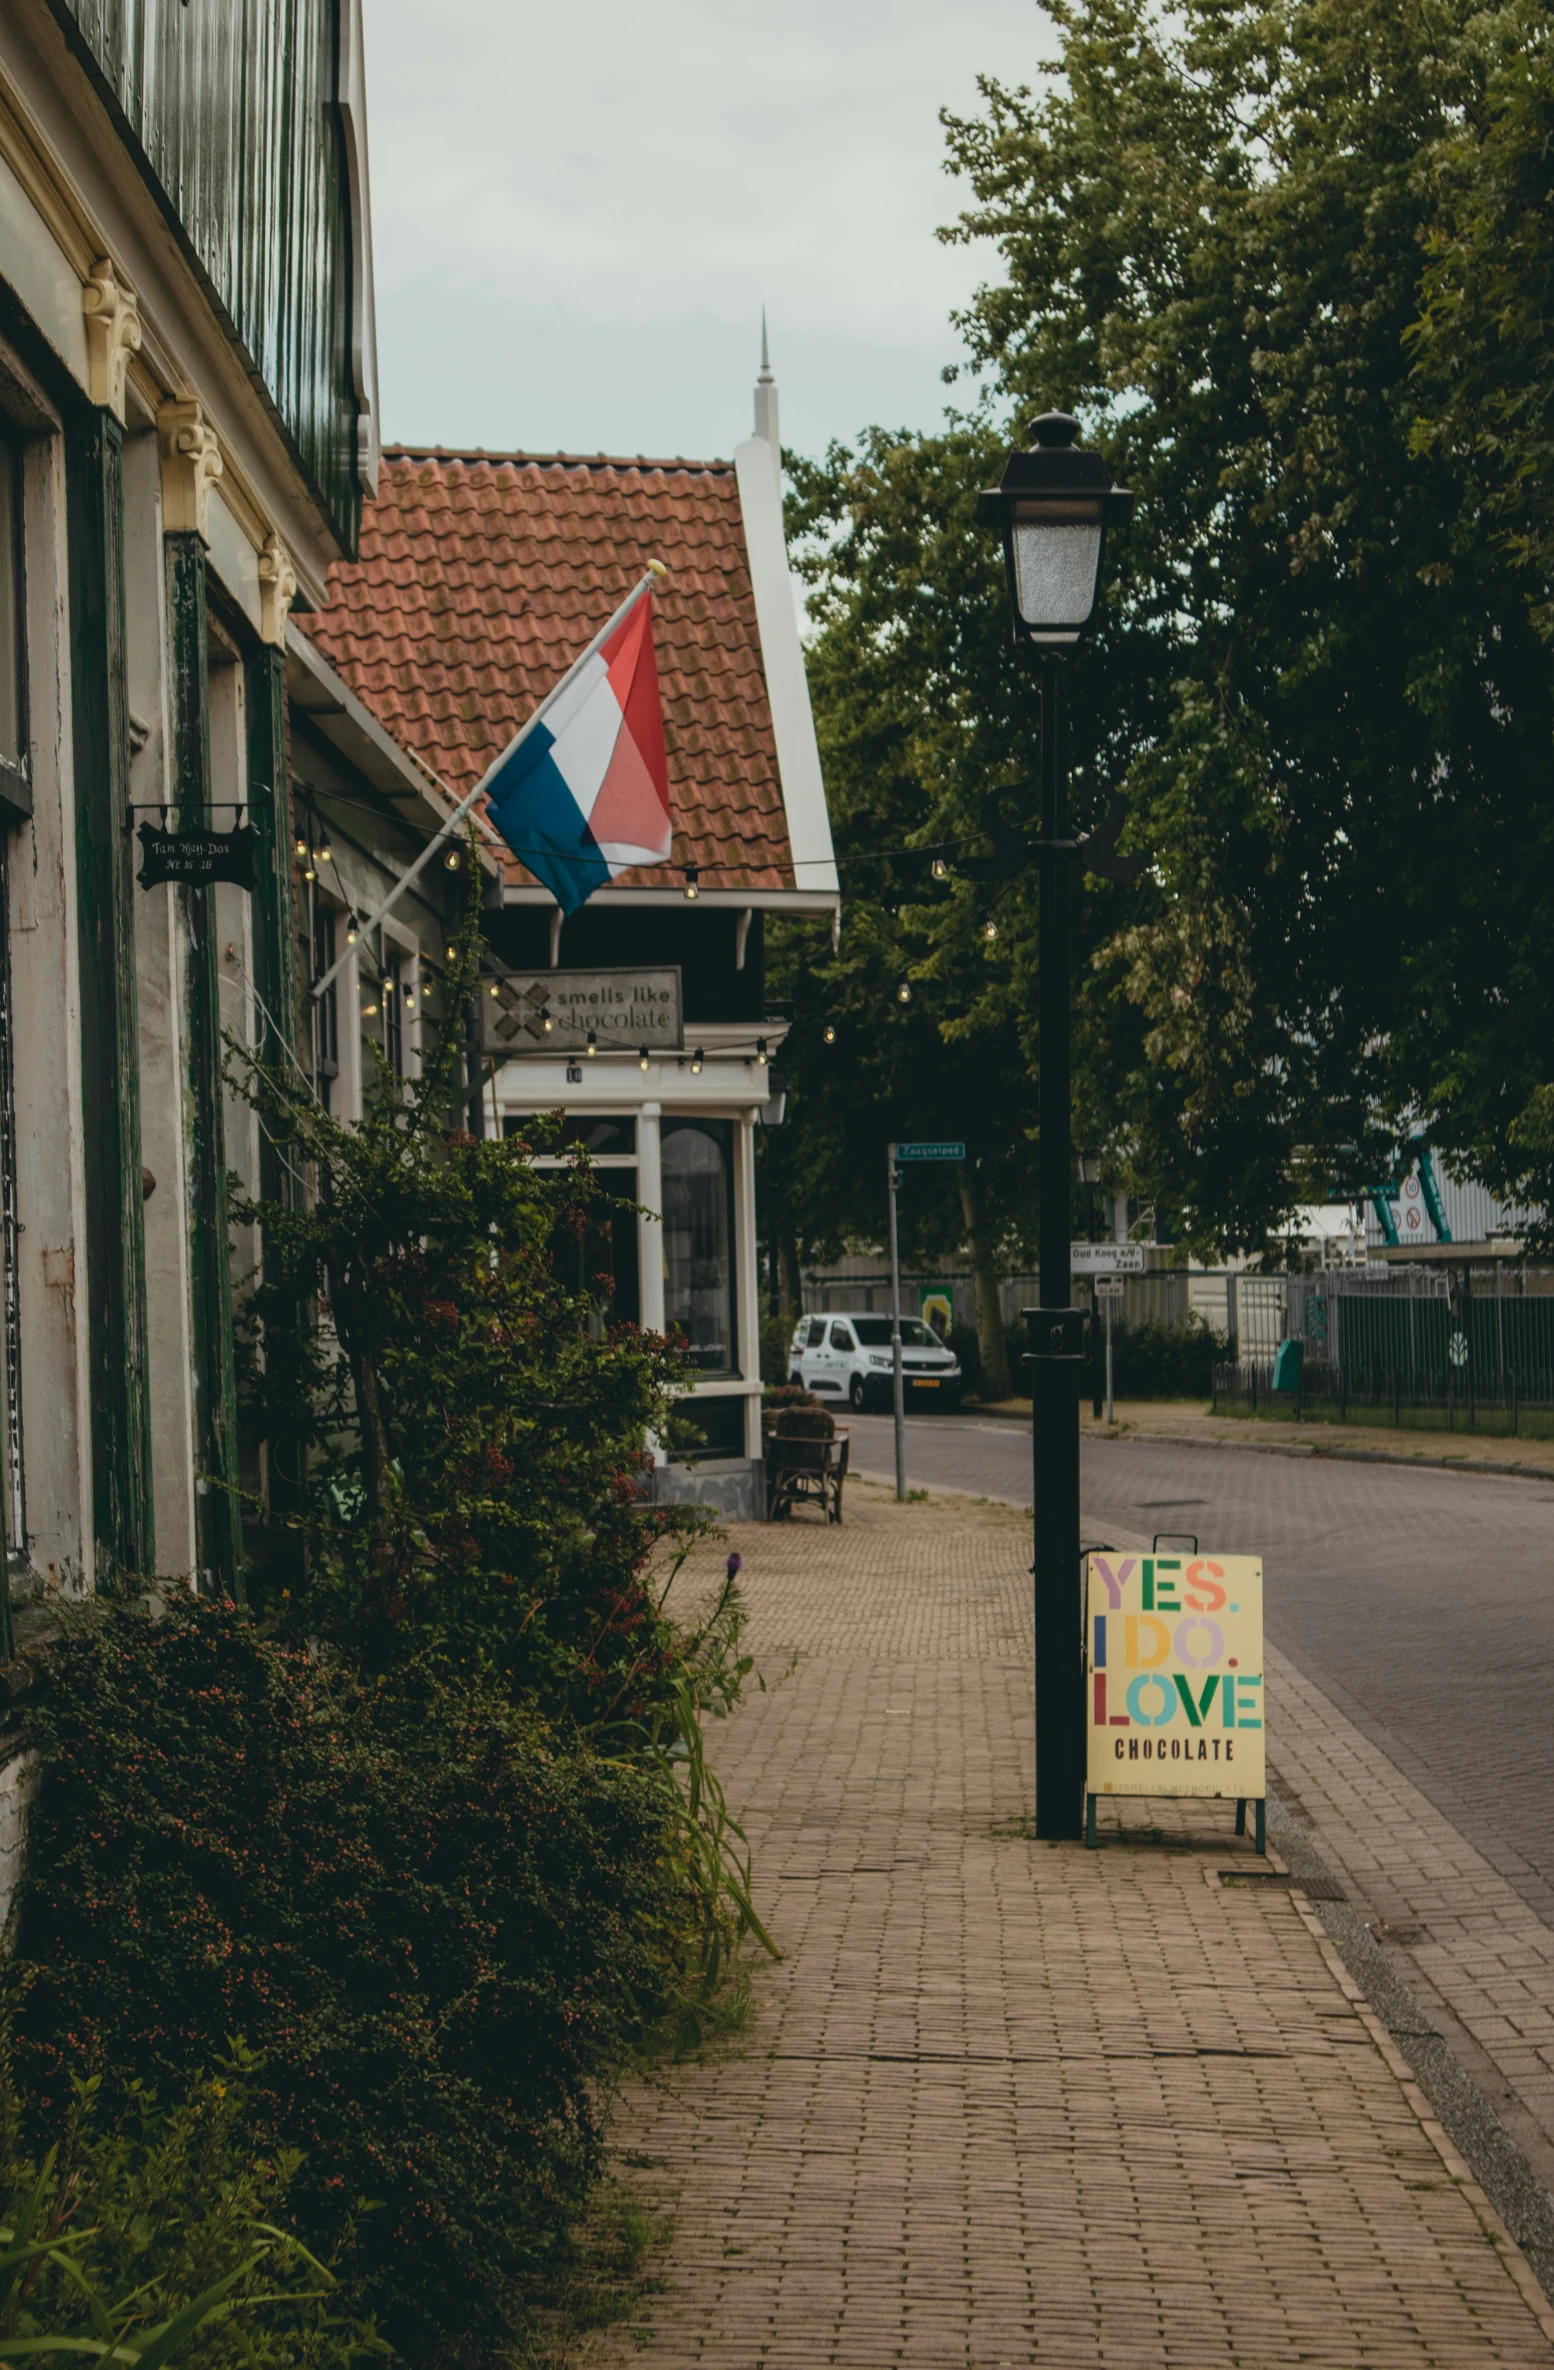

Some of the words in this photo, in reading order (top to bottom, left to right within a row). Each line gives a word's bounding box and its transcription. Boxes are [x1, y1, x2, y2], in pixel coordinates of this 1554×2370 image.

[557, 986, 625, 1005] smells
[633, 986, 671, 1004] like
[557, 1005, 671, 1031] chocolate
[1073, 1248, 1091, 1258] Oud
[1095, 1248, 1117, 1260] Koog
[1116, 1260, 1140, 1268] Zaan
[1092, 1557, 1240, 1613] YES.
[1093, 1615, 1107, 1668] I
[1125, 1615, 1239, 1669] DO.
[1093, 1673, 1262, 1729] LOVE
[1115, 1737, 1235, 1762] CHOCOLATE
